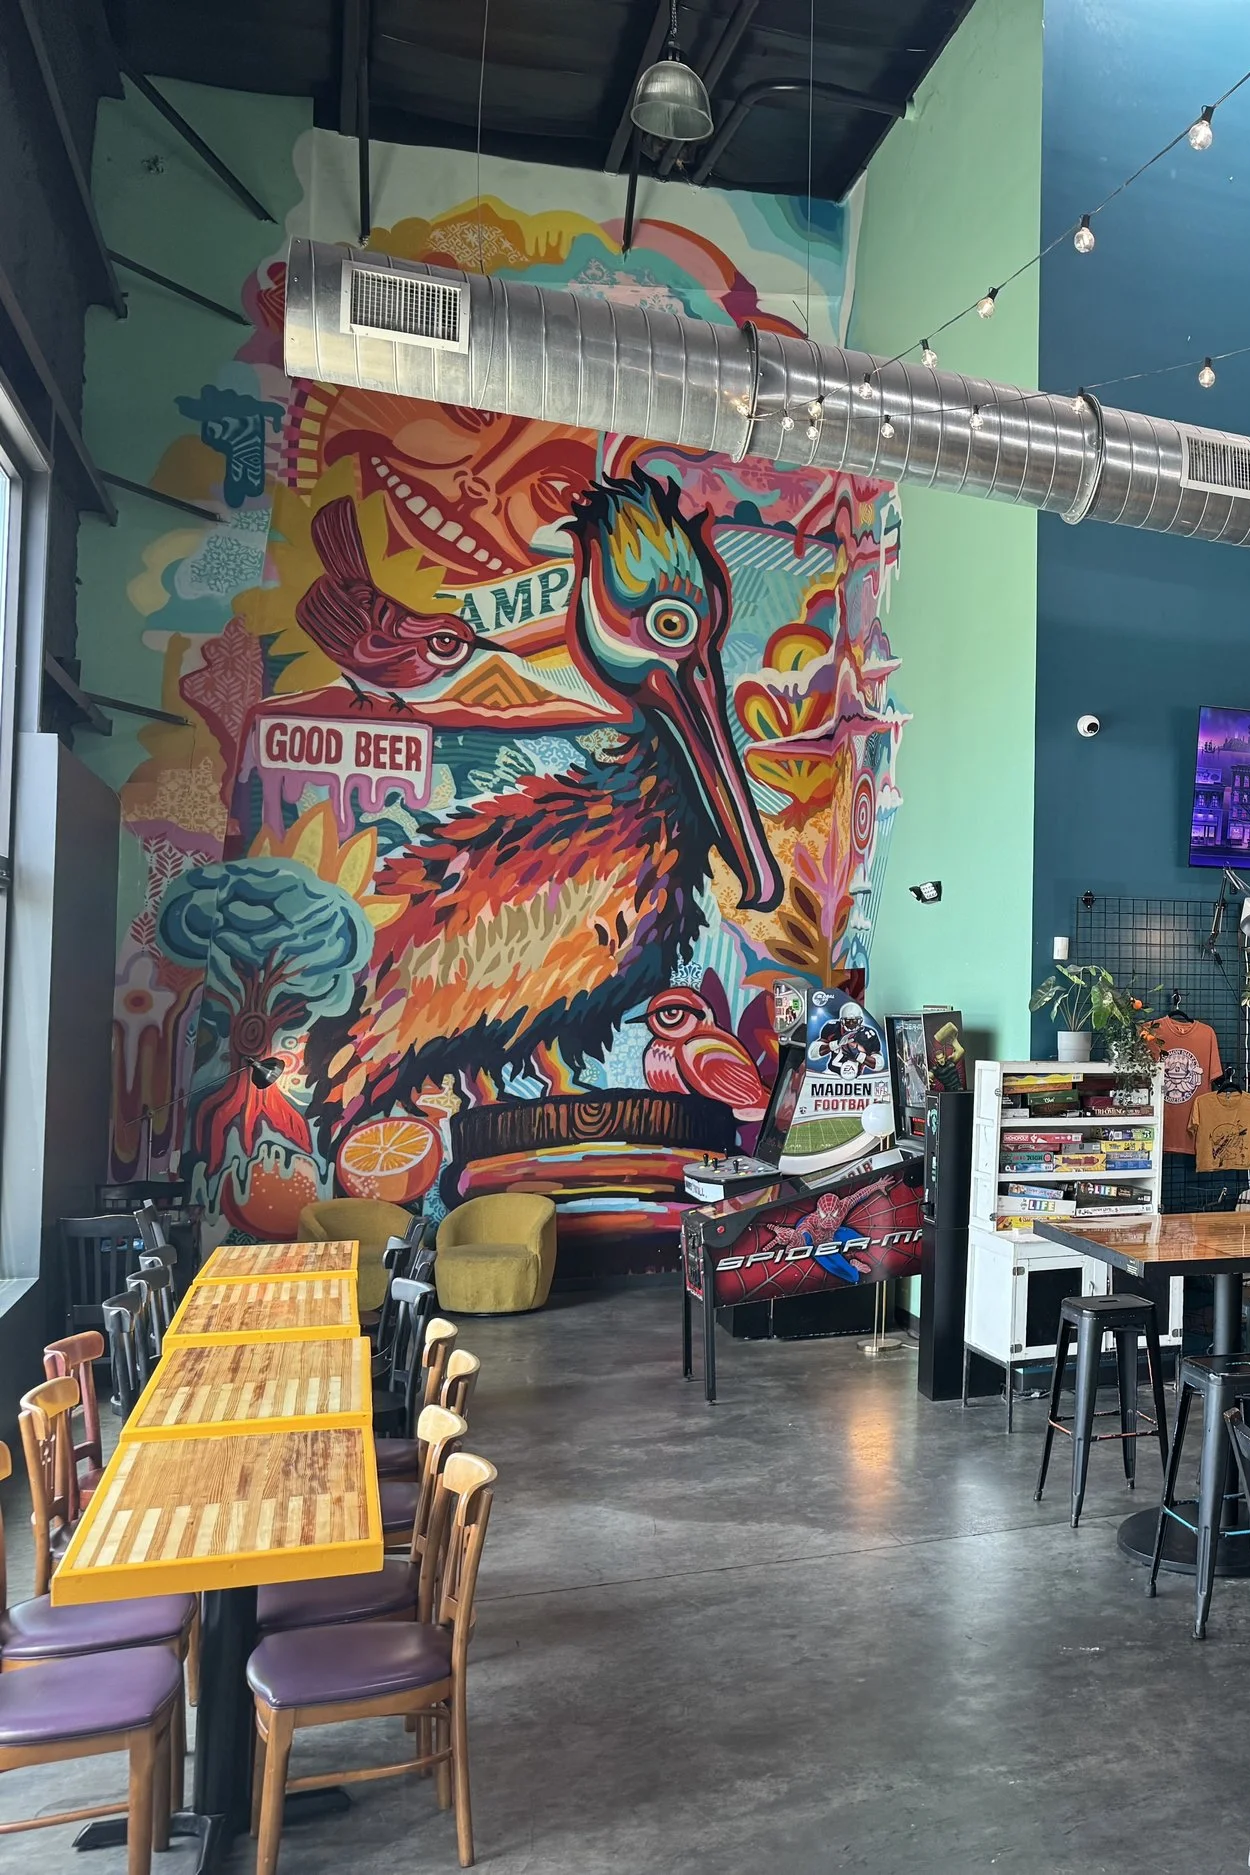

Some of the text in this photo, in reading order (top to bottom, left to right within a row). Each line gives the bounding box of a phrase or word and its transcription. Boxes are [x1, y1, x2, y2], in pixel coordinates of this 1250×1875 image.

[433, 566, 576, 634] AMP
[265, 722, 423, 773] GOOD BEER
[811, 1083, 872, 1096] MADDEN
[814, 1098, 877, 1112] FOOTBAL
[1094, 1184, 1117, 1196] LIFE
[1029, 1201, 1055, 1211] LIFE
